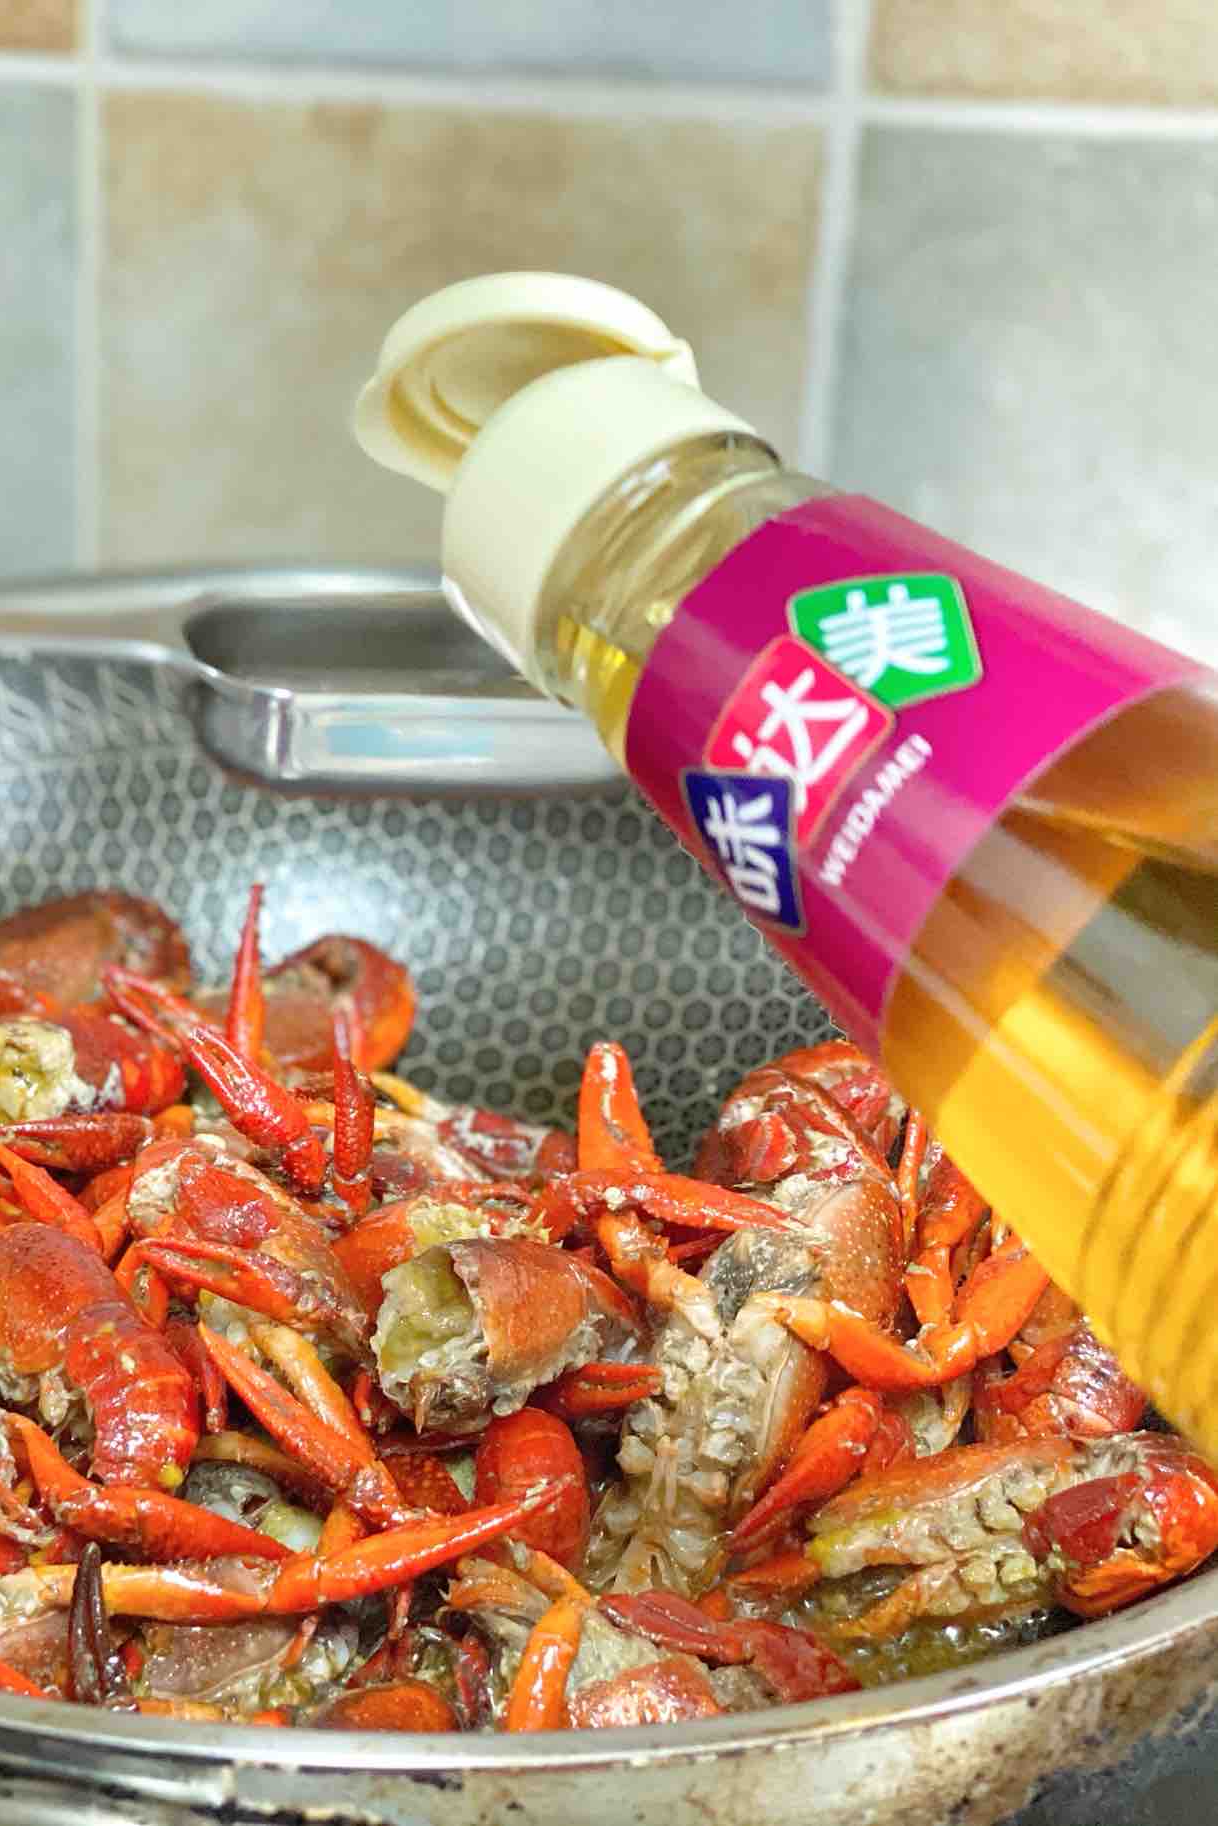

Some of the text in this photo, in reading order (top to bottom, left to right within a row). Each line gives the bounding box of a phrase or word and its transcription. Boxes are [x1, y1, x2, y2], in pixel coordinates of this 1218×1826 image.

[705, 583, 951, 914] 味达美
[819, 733, 933, 886] WEIDAMEI
